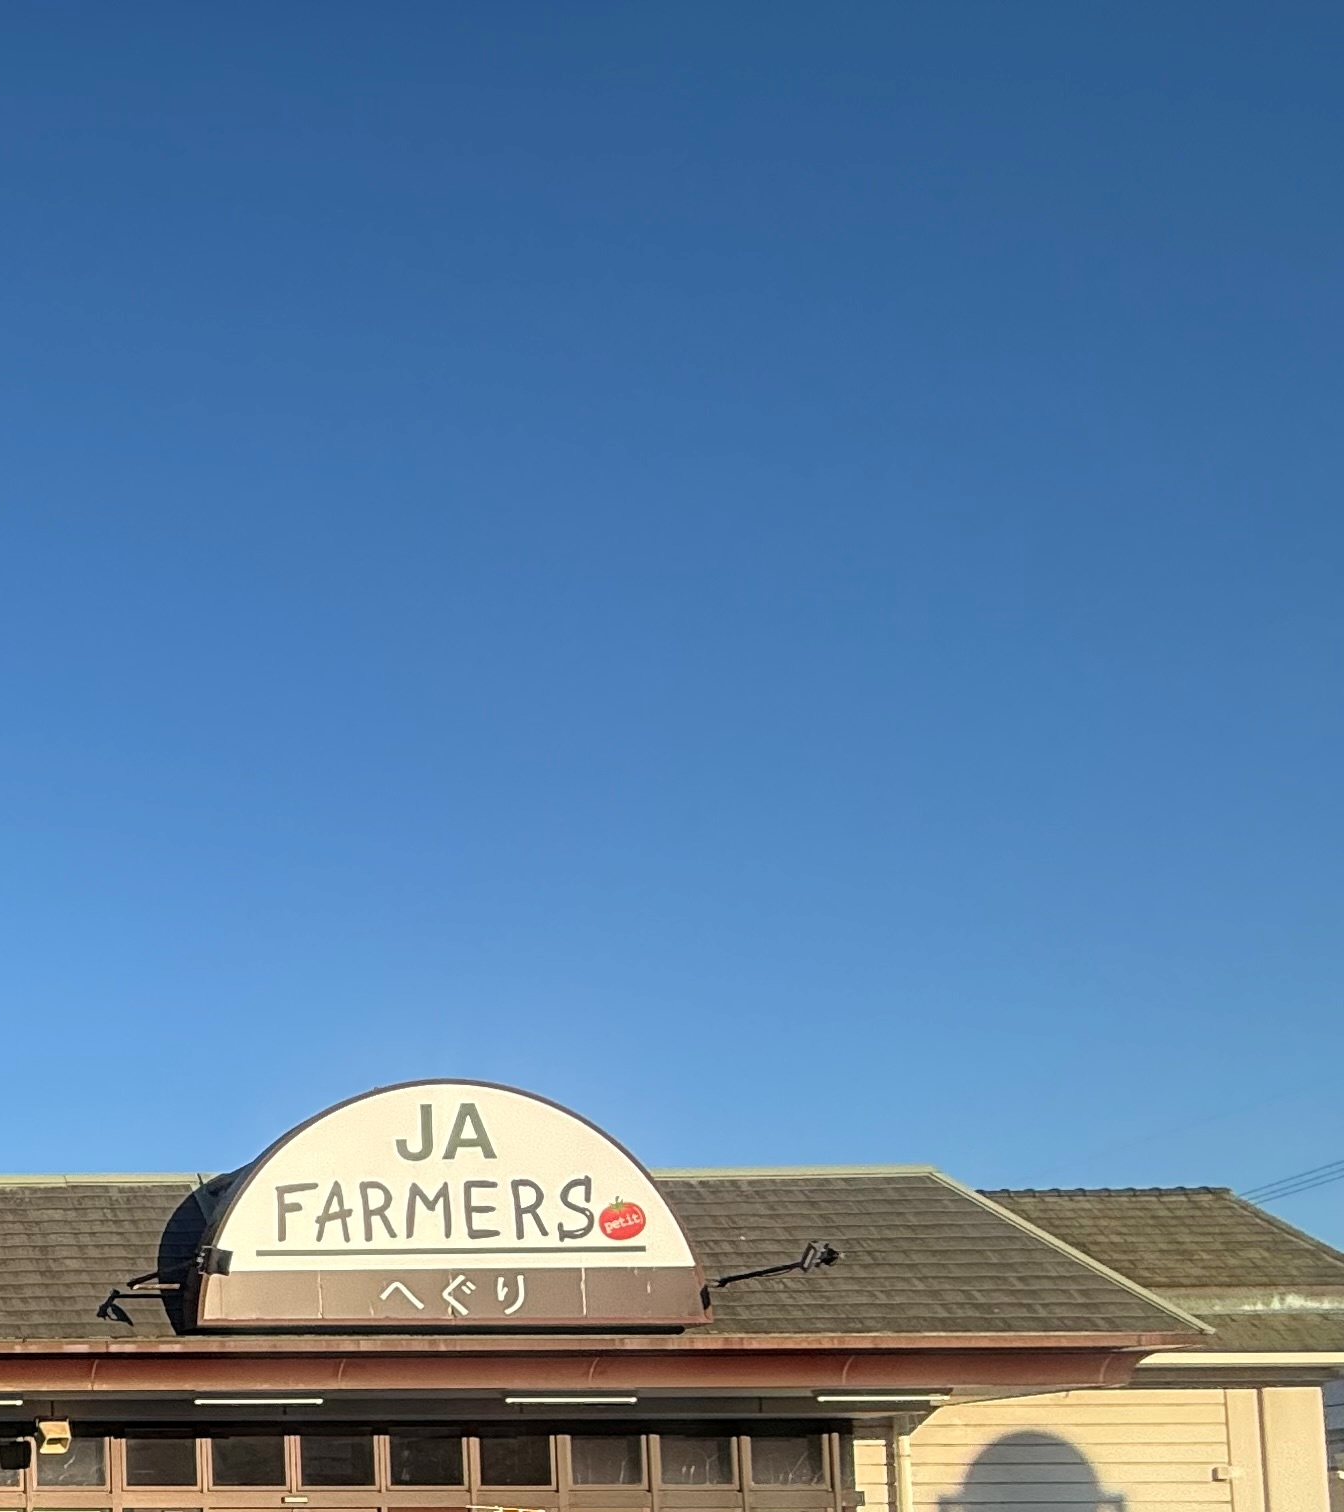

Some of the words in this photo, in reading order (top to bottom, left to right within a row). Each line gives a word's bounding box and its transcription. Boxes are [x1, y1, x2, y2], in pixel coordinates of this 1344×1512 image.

[395, 1102, 498, 1162] JA
[275, 1175, 594, 1243] FARMERS
[603, 1212, 642, 1234] petit
[379, 1273, 526, 1317] へぐり
